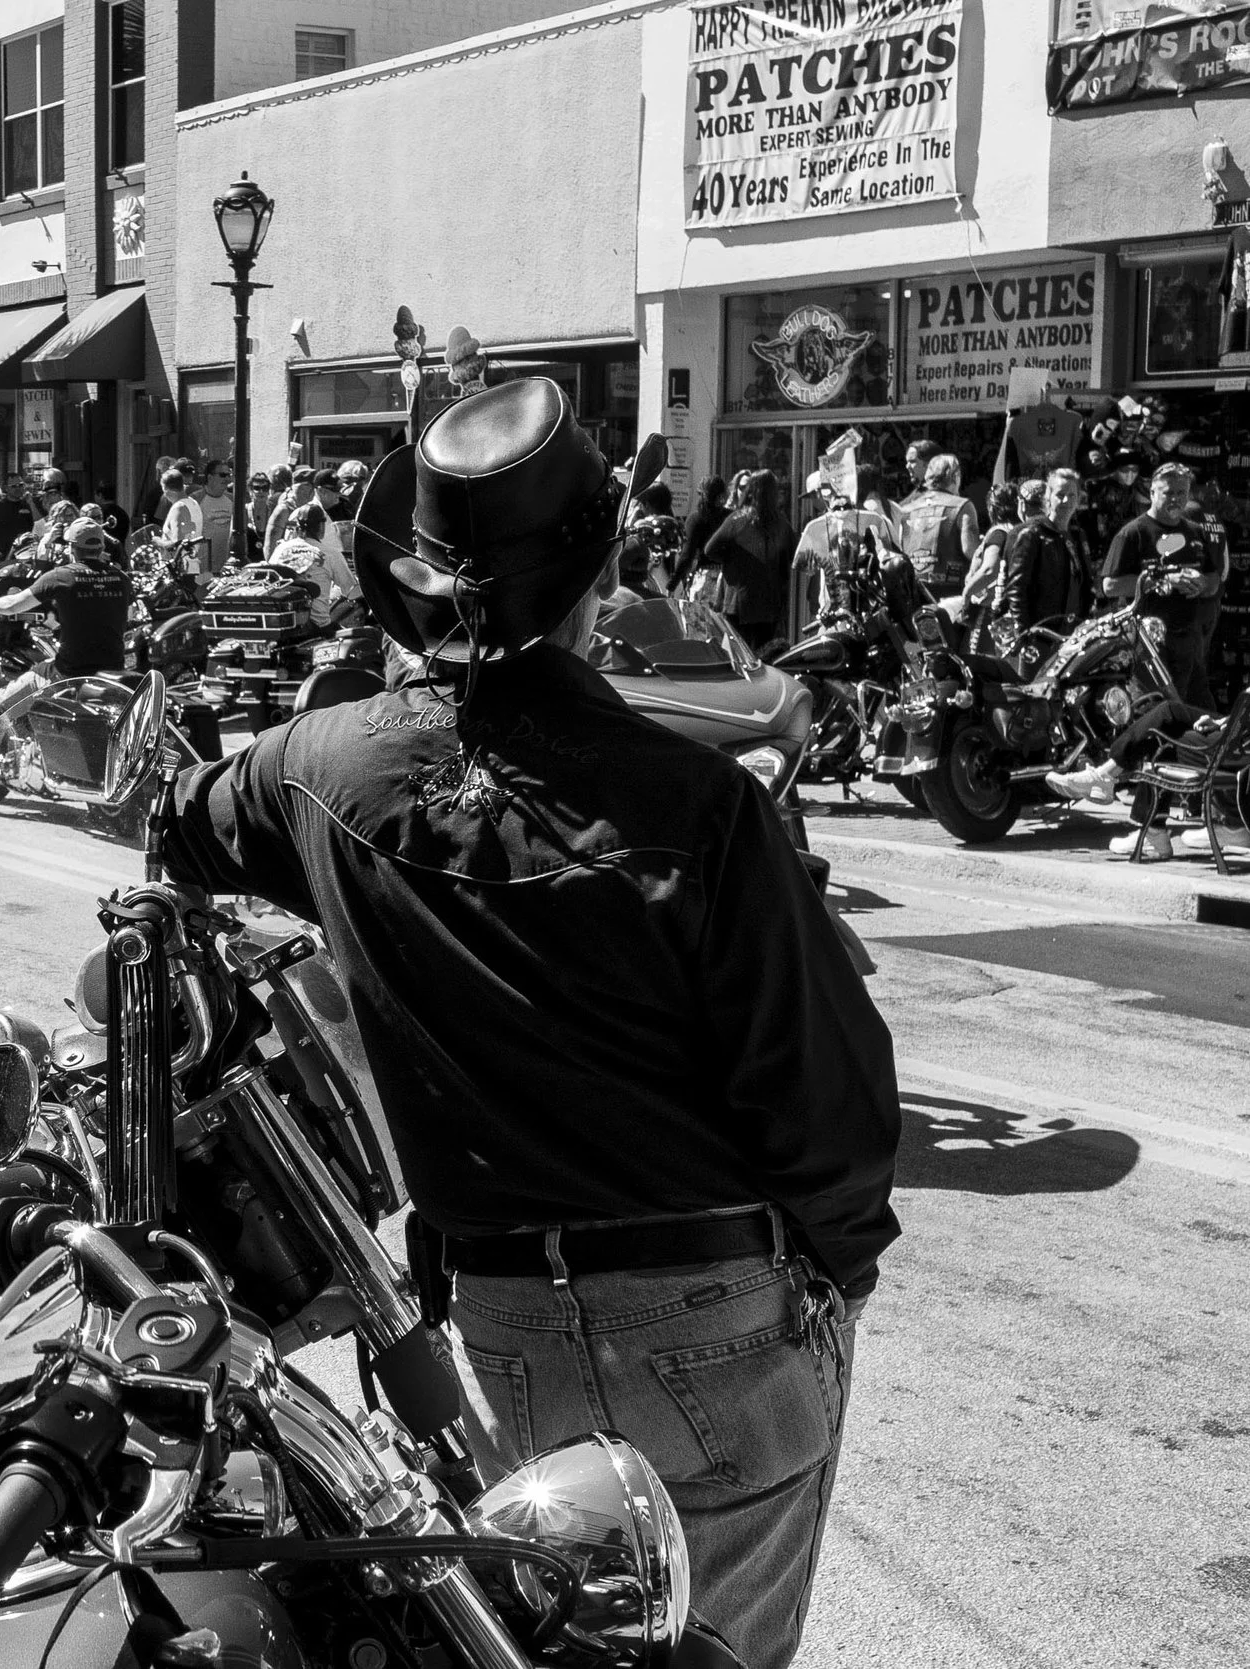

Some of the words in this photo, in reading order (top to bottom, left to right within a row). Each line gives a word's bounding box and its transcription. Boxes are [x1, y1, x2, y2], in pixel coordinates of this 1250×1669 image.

[695, 5, 751, 53] HAPPY
[695, 23, 956, 113] PATCHES
[1195, 60, 1225, 78] THE
[696, 111, 754, 140] MORE
[765, 101, 822, 129] THAN
[834, 77, 952, 120] ANYBODY
[760, 131, 811, 152] EXPERT
[816, 119, 874, 145] SEWING
[799, 147, 888, 182] Experience
[896, 143, 911, 165] In
[921, 137, 951, 161] The
[692, 171, 724, 220] 40
[729, 175, 789, 209] Years
[810, 187, 851, 208] Same
[860, 174, 934, 201] Location
[918, 271, 1095, 329] PATCHES
[781, 310, 838, 341] BULLDOG
[918, 332, 958, 357] MORE
[962, 328, 1008, 353] THAN
[1014, 322, 1092, 349] ANYBODY
[916, 363, 952, 382] Expert
[953, 359, 1004, 379] Repairs
[919, 386, 947, 402] Here
[951, 383, 982, 402] Every
